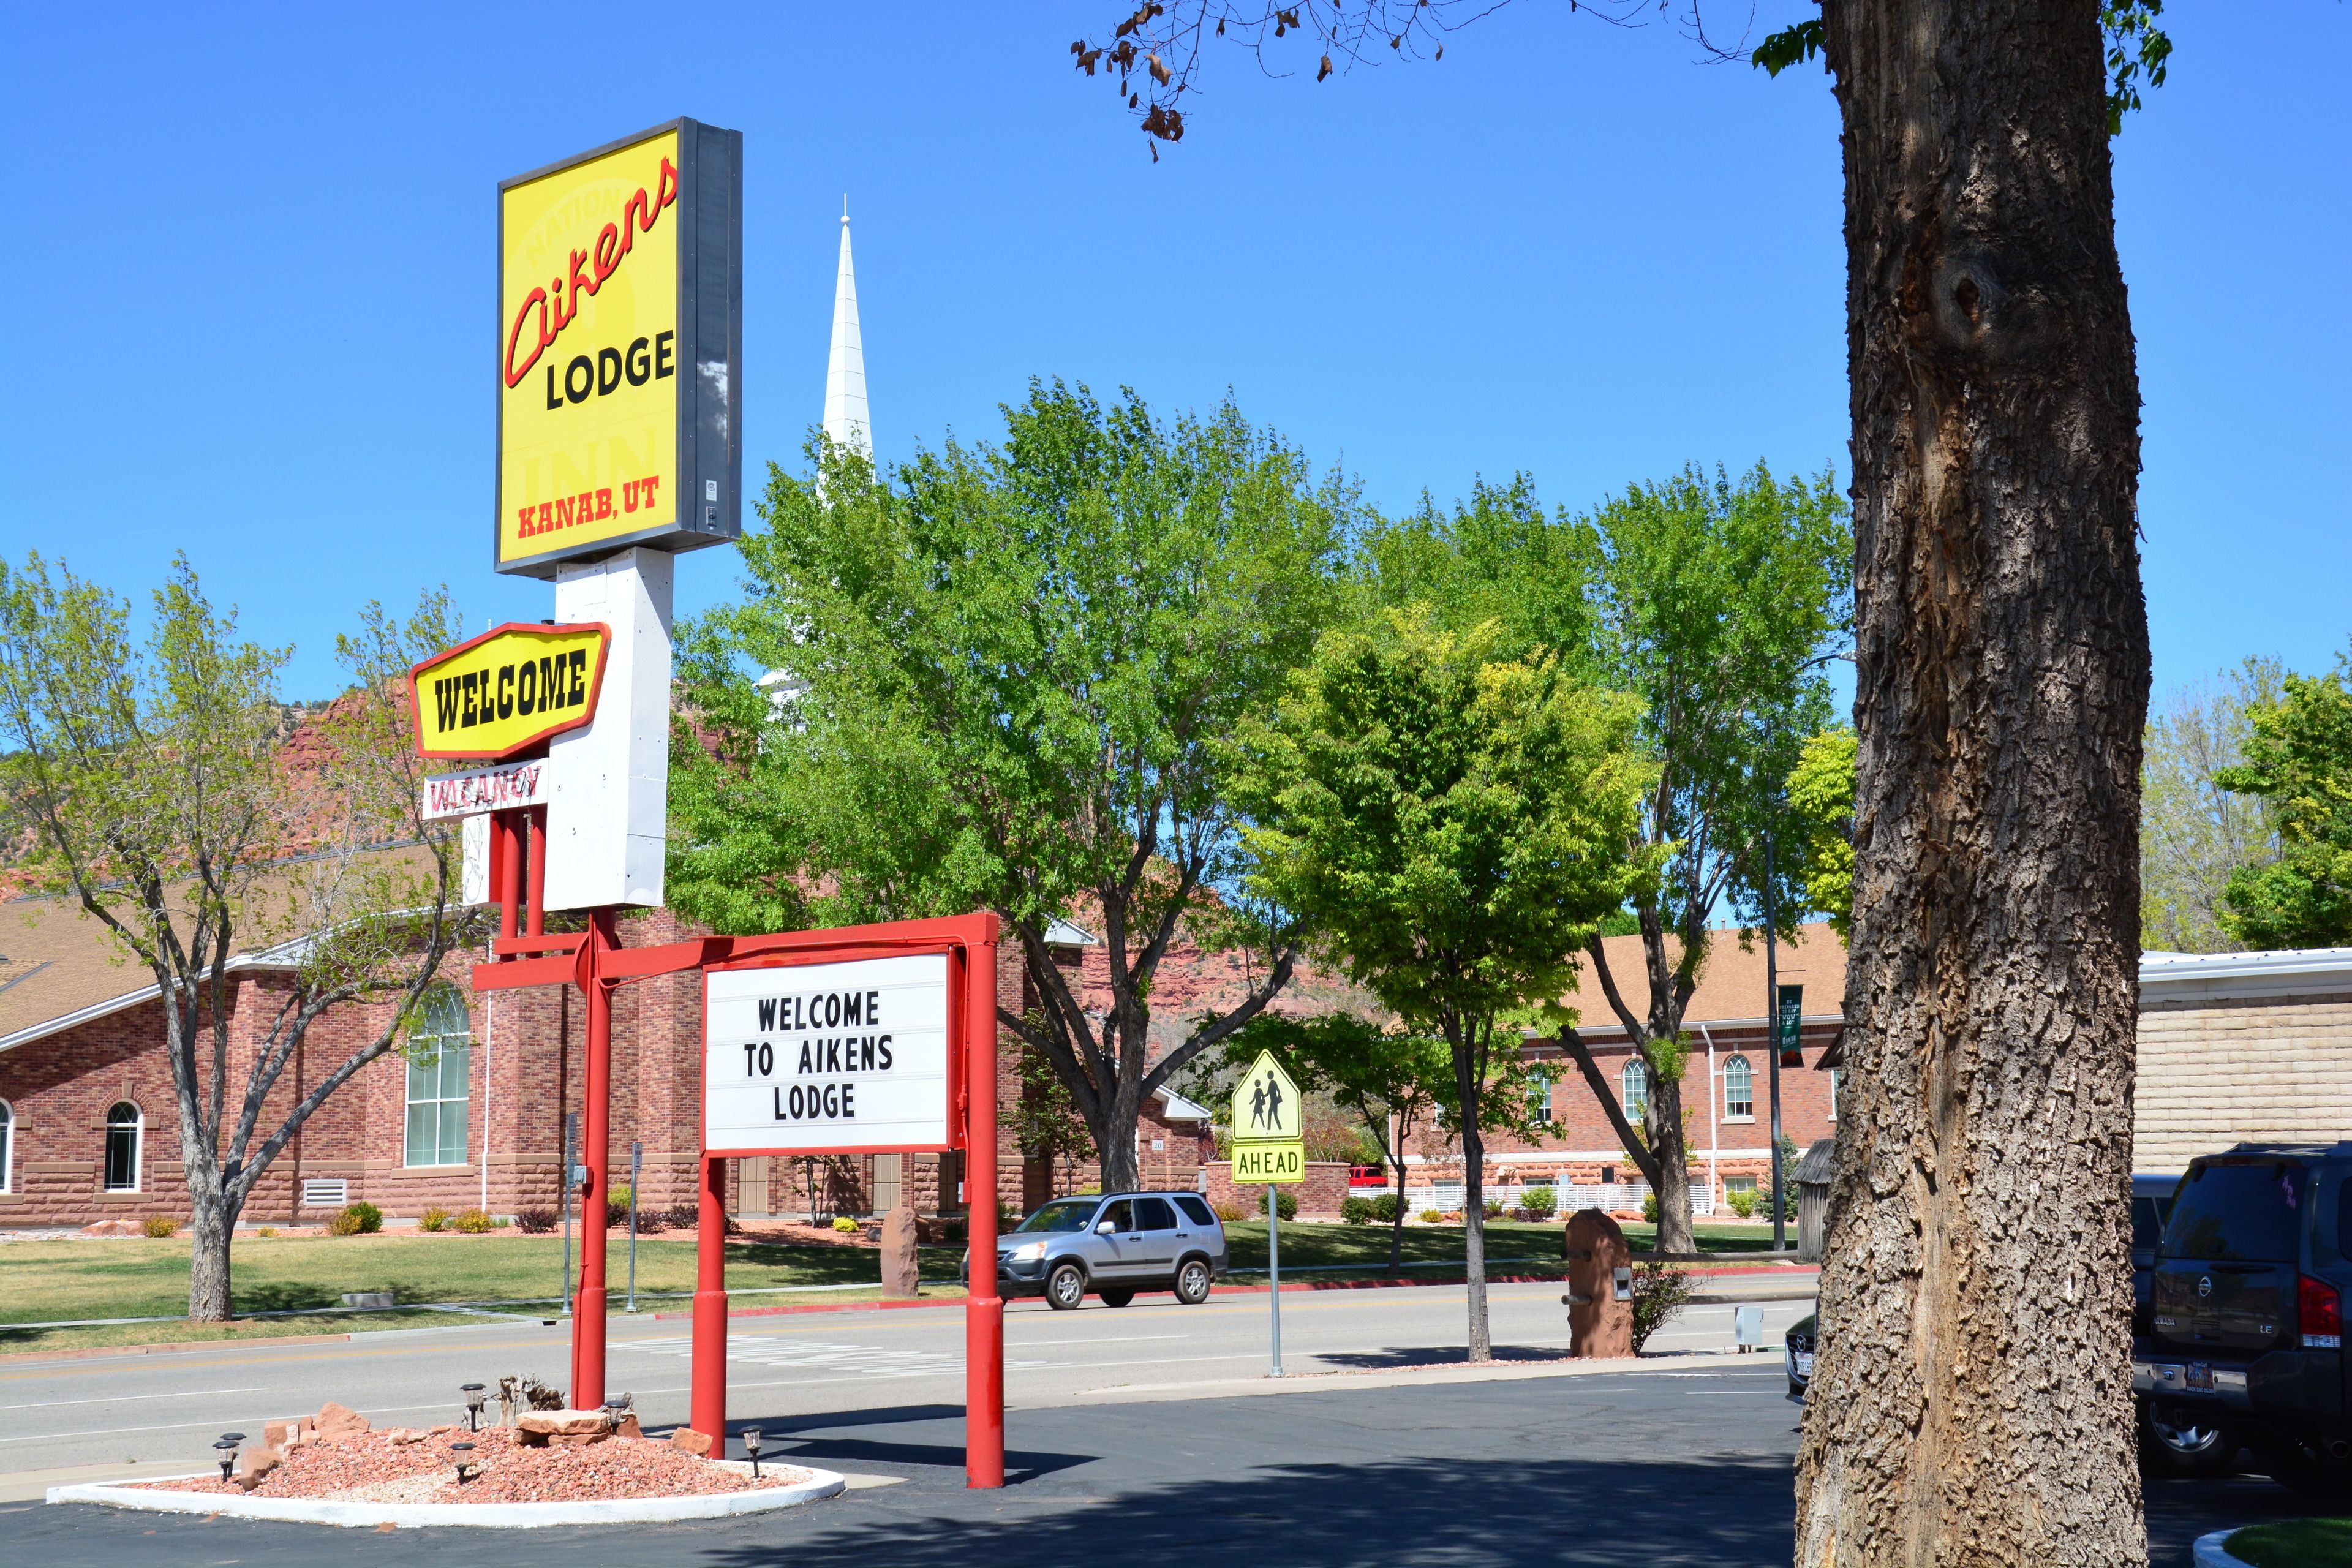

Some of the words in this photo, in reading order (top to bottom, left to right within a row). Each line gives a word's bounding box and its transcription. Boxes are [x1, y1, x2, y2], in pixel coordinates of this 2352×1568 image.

[505, 155, 677, 388] Aikens
[546, 330, 674, 411] LODGE
[518, 488, 618, 539] KANAB,
[622, 475, 659, 513] UT
[434, 648, 586, 733] WELCOME
[430, 766, 542, 812] VACANCY
[758, 990, 879, 1032] WELCOME
[744, 1042, 774, 1077] TO
[798, 1034, 892, 1075] AIKENS
[774, 1083, 855, 1120] LODGE
[1238, 1152, 1298, 1174] AHEAD
[2260, 1325, 2272, 1333] LE
